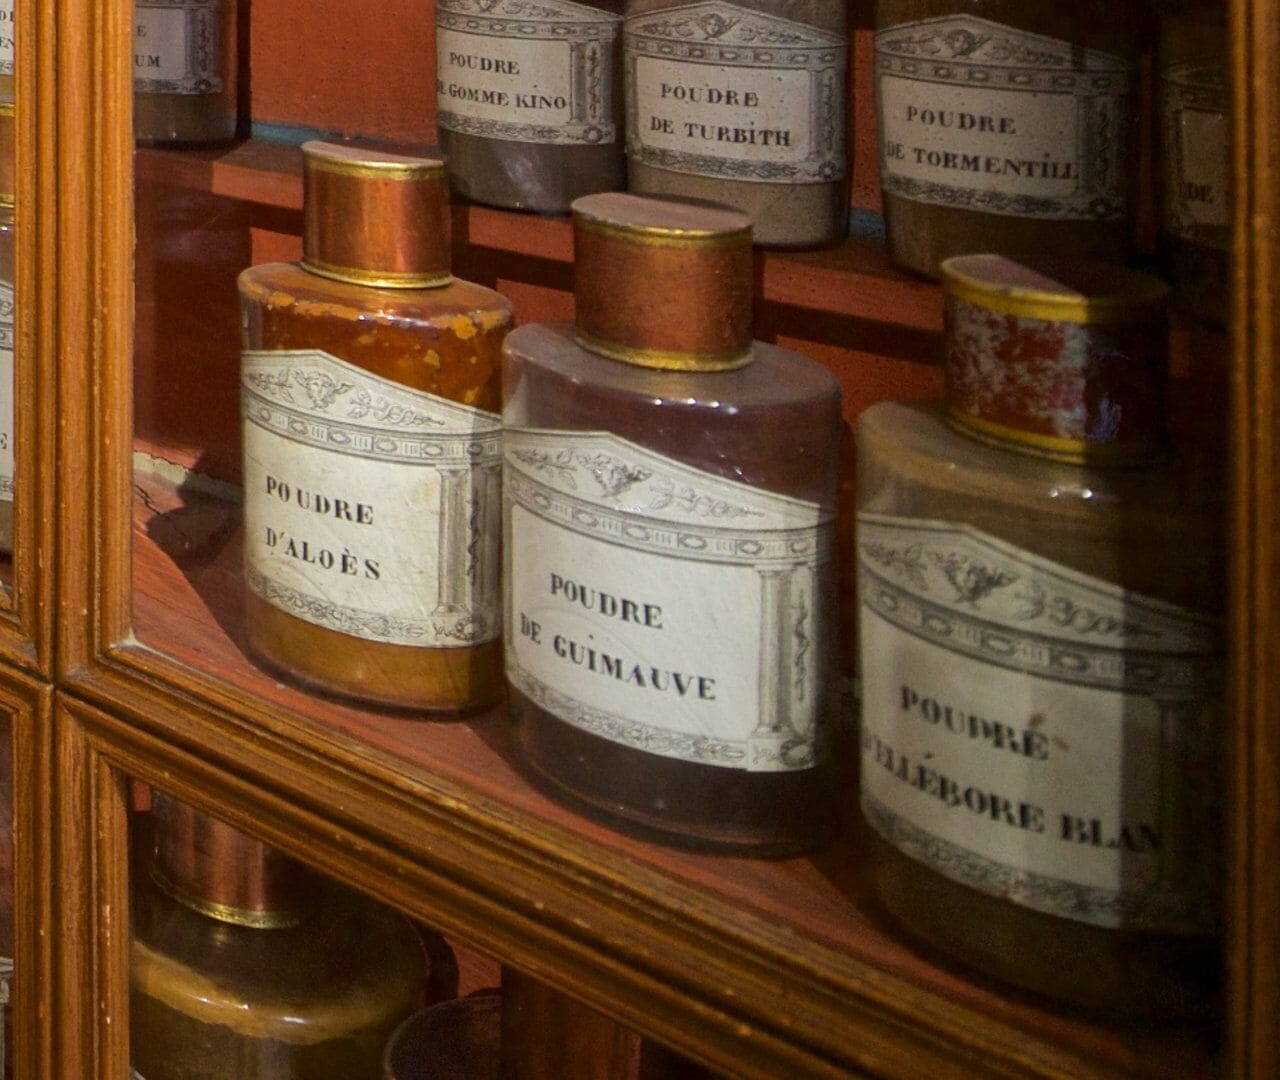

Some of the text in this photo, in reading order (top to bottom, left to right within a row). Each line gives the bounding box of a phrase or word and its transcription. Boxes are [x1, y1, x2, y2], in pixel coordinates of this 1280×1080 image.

[450, 51, 520, 75] POUDRE
[448, 83, 510, 107] GOMME
[515, 92, 567, 110] KINO
[661, 83, 760, 108] POUDRE
[651, 116, 792, 148] DE TURBITH
[906, 105, 1017, 136] POUDRE
[886, 141, 905, 162] DE
[265, 475, 375, 526] POUDRE
[265, 527, 382, 581] D'ALOÈS
[550, 572, 663, 630] POUDRE
[520, 612, 718, 701] DE GUIMAUVE
[900, 685, 1050, 761] POUDRE
